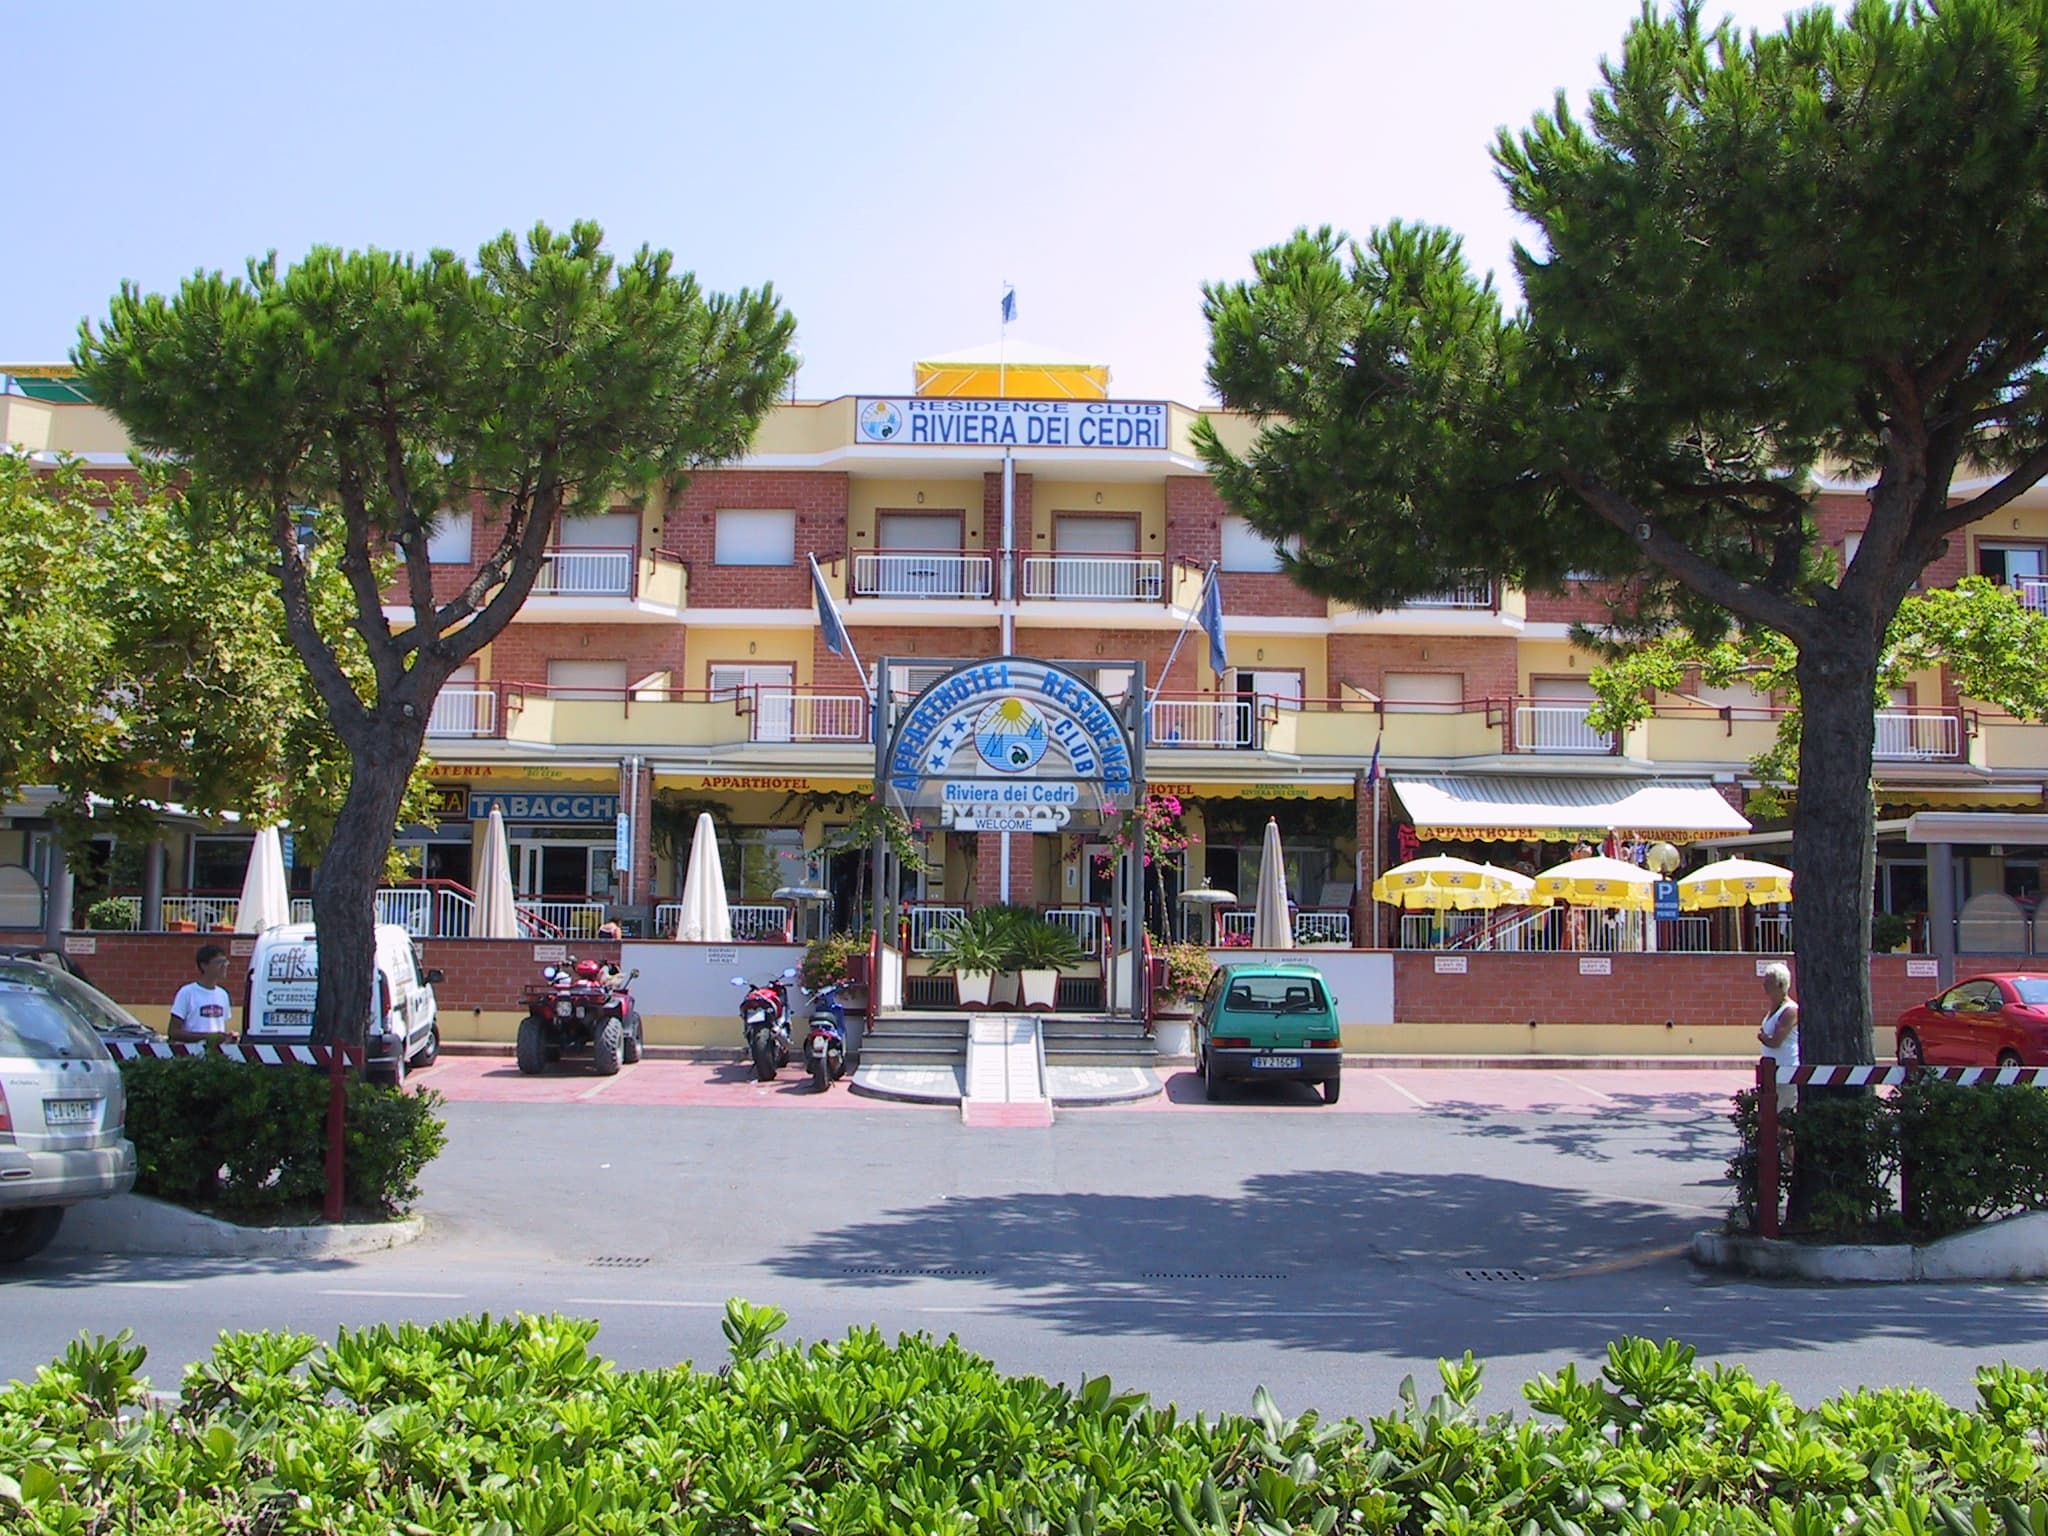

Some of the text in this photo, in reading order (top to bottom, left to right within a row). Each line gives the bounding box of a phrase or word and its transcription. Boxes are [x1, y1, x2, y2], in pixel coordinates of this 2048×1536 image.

[909, 401, 1162, 416] RESIDENCE CLUB
[912, 413, 1159, 447] RIVIERA DEI CEDRI
[892, 664, 1131, 796] APPARTHOTEL RESIDENCE
[1054, 718, 1095, 774] CLUB
[701, 777, 810, 789] APPARTHOTEL
[946, 784, 1075, 802] Riviera dei Cedri
[975, 819, 1033, 830] WELCOME
[1424, 827, 1537, 839] APPARTHOTEL
[1659, 883, 1673, 900] P
